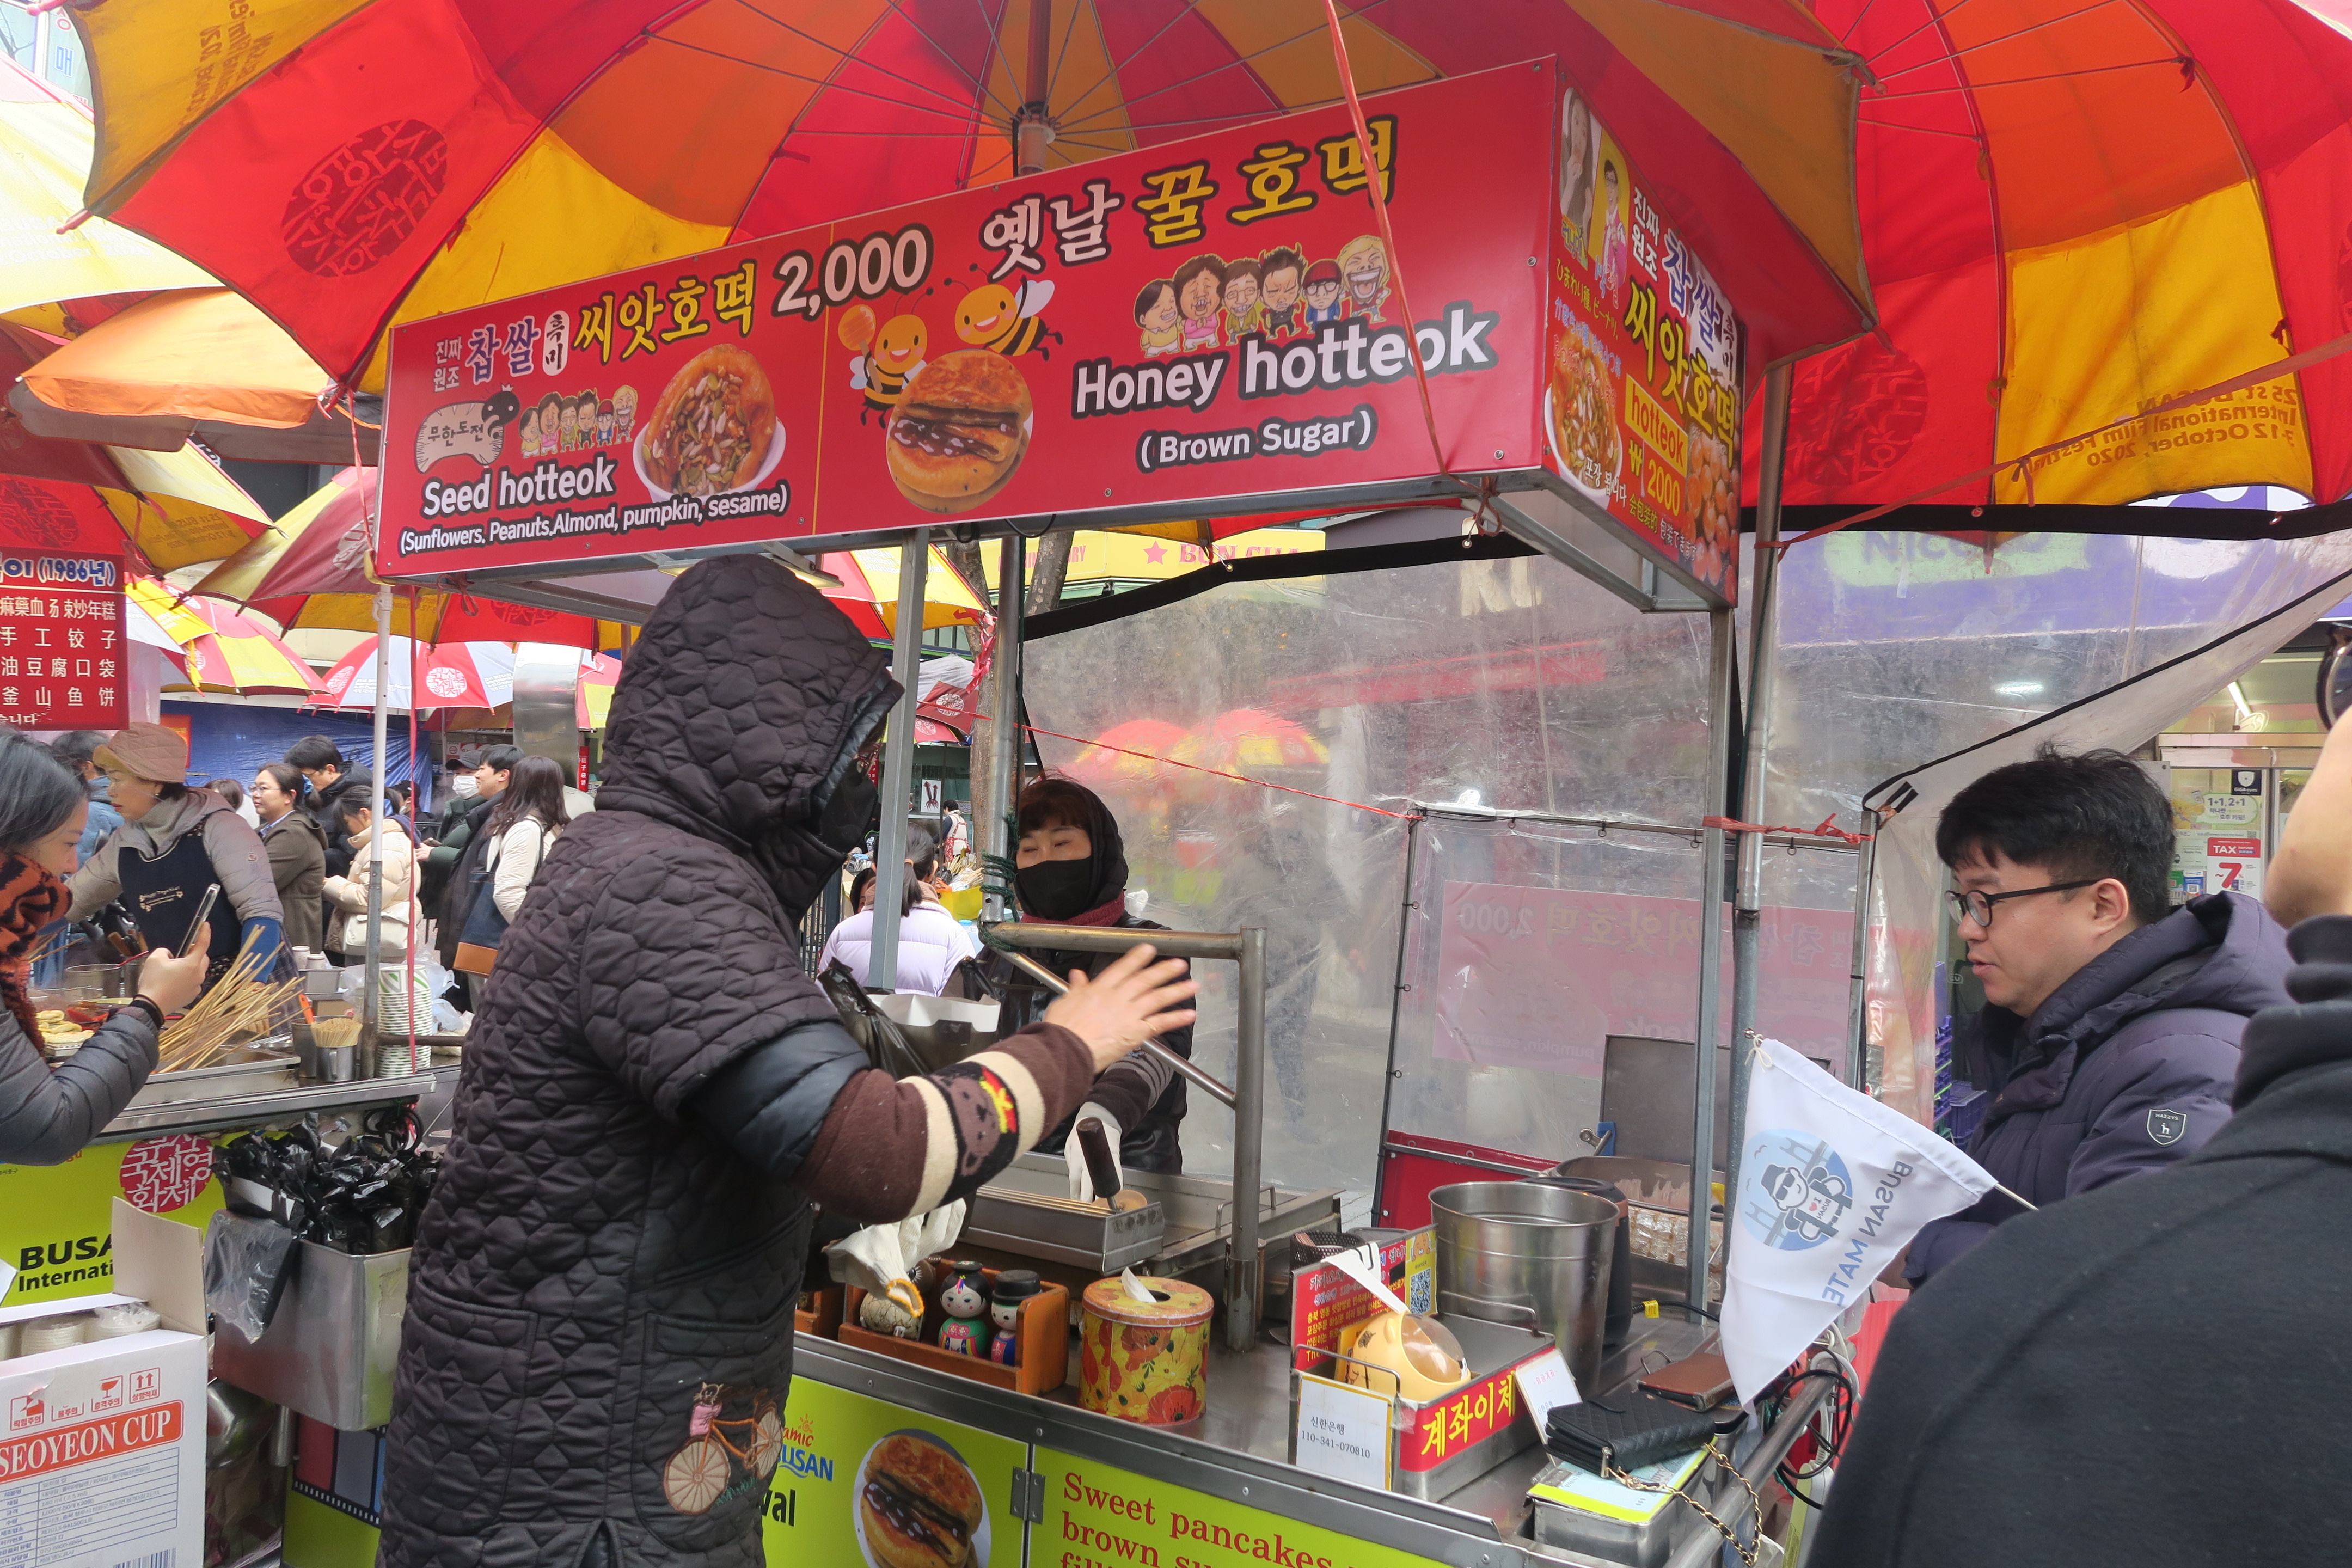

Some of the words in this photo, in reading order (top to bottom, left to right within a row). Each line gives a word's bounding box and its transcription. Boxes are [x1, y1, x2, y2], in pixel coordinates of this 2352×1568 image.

[982, 182, 1120, 280] 옛날
[1138, 166, 1214, 246] 꿀
[1232, 119, 1394, 221] 호떡
[1633, 187, 1659, 246] 진짜
[776, 229, 928, 317] 2,000
[1632, 224, 1658, 282] 원조
[573, 259, 756, 364] 씨앗호떡
[1662, 229, 1720, 352] 찹쌀
[436, 336, 463, 364] 진짜
[465, 315, 541, 384] 찹쌀
[546, 314, 566, 371] 흑미
[1076, 357, 1224, 413] Honey
[1246, 309, 1490, 394] hotteok
[433, 366, 460, 392] 원조
[1625, 281, 1736, 468] 씨앗호떡
[428, 420, 484, 448] 무한도전
[1632, 384, 1684, 468] hotteok
[424, 478, 489, 516] Seed
[499, 457, 616, 507] hotteok
[1585, 457, 1602, 487] 포장
[1647, 459, 1680, 516] 2000
[623, 499, 703, 526] pumpkin,
[708, 486, 789, 516] sesame)
[39, 557, 117, 587] (1986년)
[2, 686, 115, 707] 釜山鱼饼
[2228, 798, 2246, 806] 2+1
[2213, 845, 2237, 854] TAX
[19, 1261, 114, 1292] Internati
[20, 1234, 113, 1271] BUSA
[1310, 1415, 1345, 1435] 신한은행
[1421, 1368, 1517, 1458] 계좌이체
[0, 1420, 118, 1478] SEOYEON
[122, 1409, 172, 1447] CUP
[777, 1444, 834, 1482] USAN
[1301, 1429, 1371, 1459] 110-341-070810
[1062, 1511, 1160, 1568] brown
[1063, 1472, 1156, 1526] Sweet
[1169, 1512, 1333, 1568] pancakes
